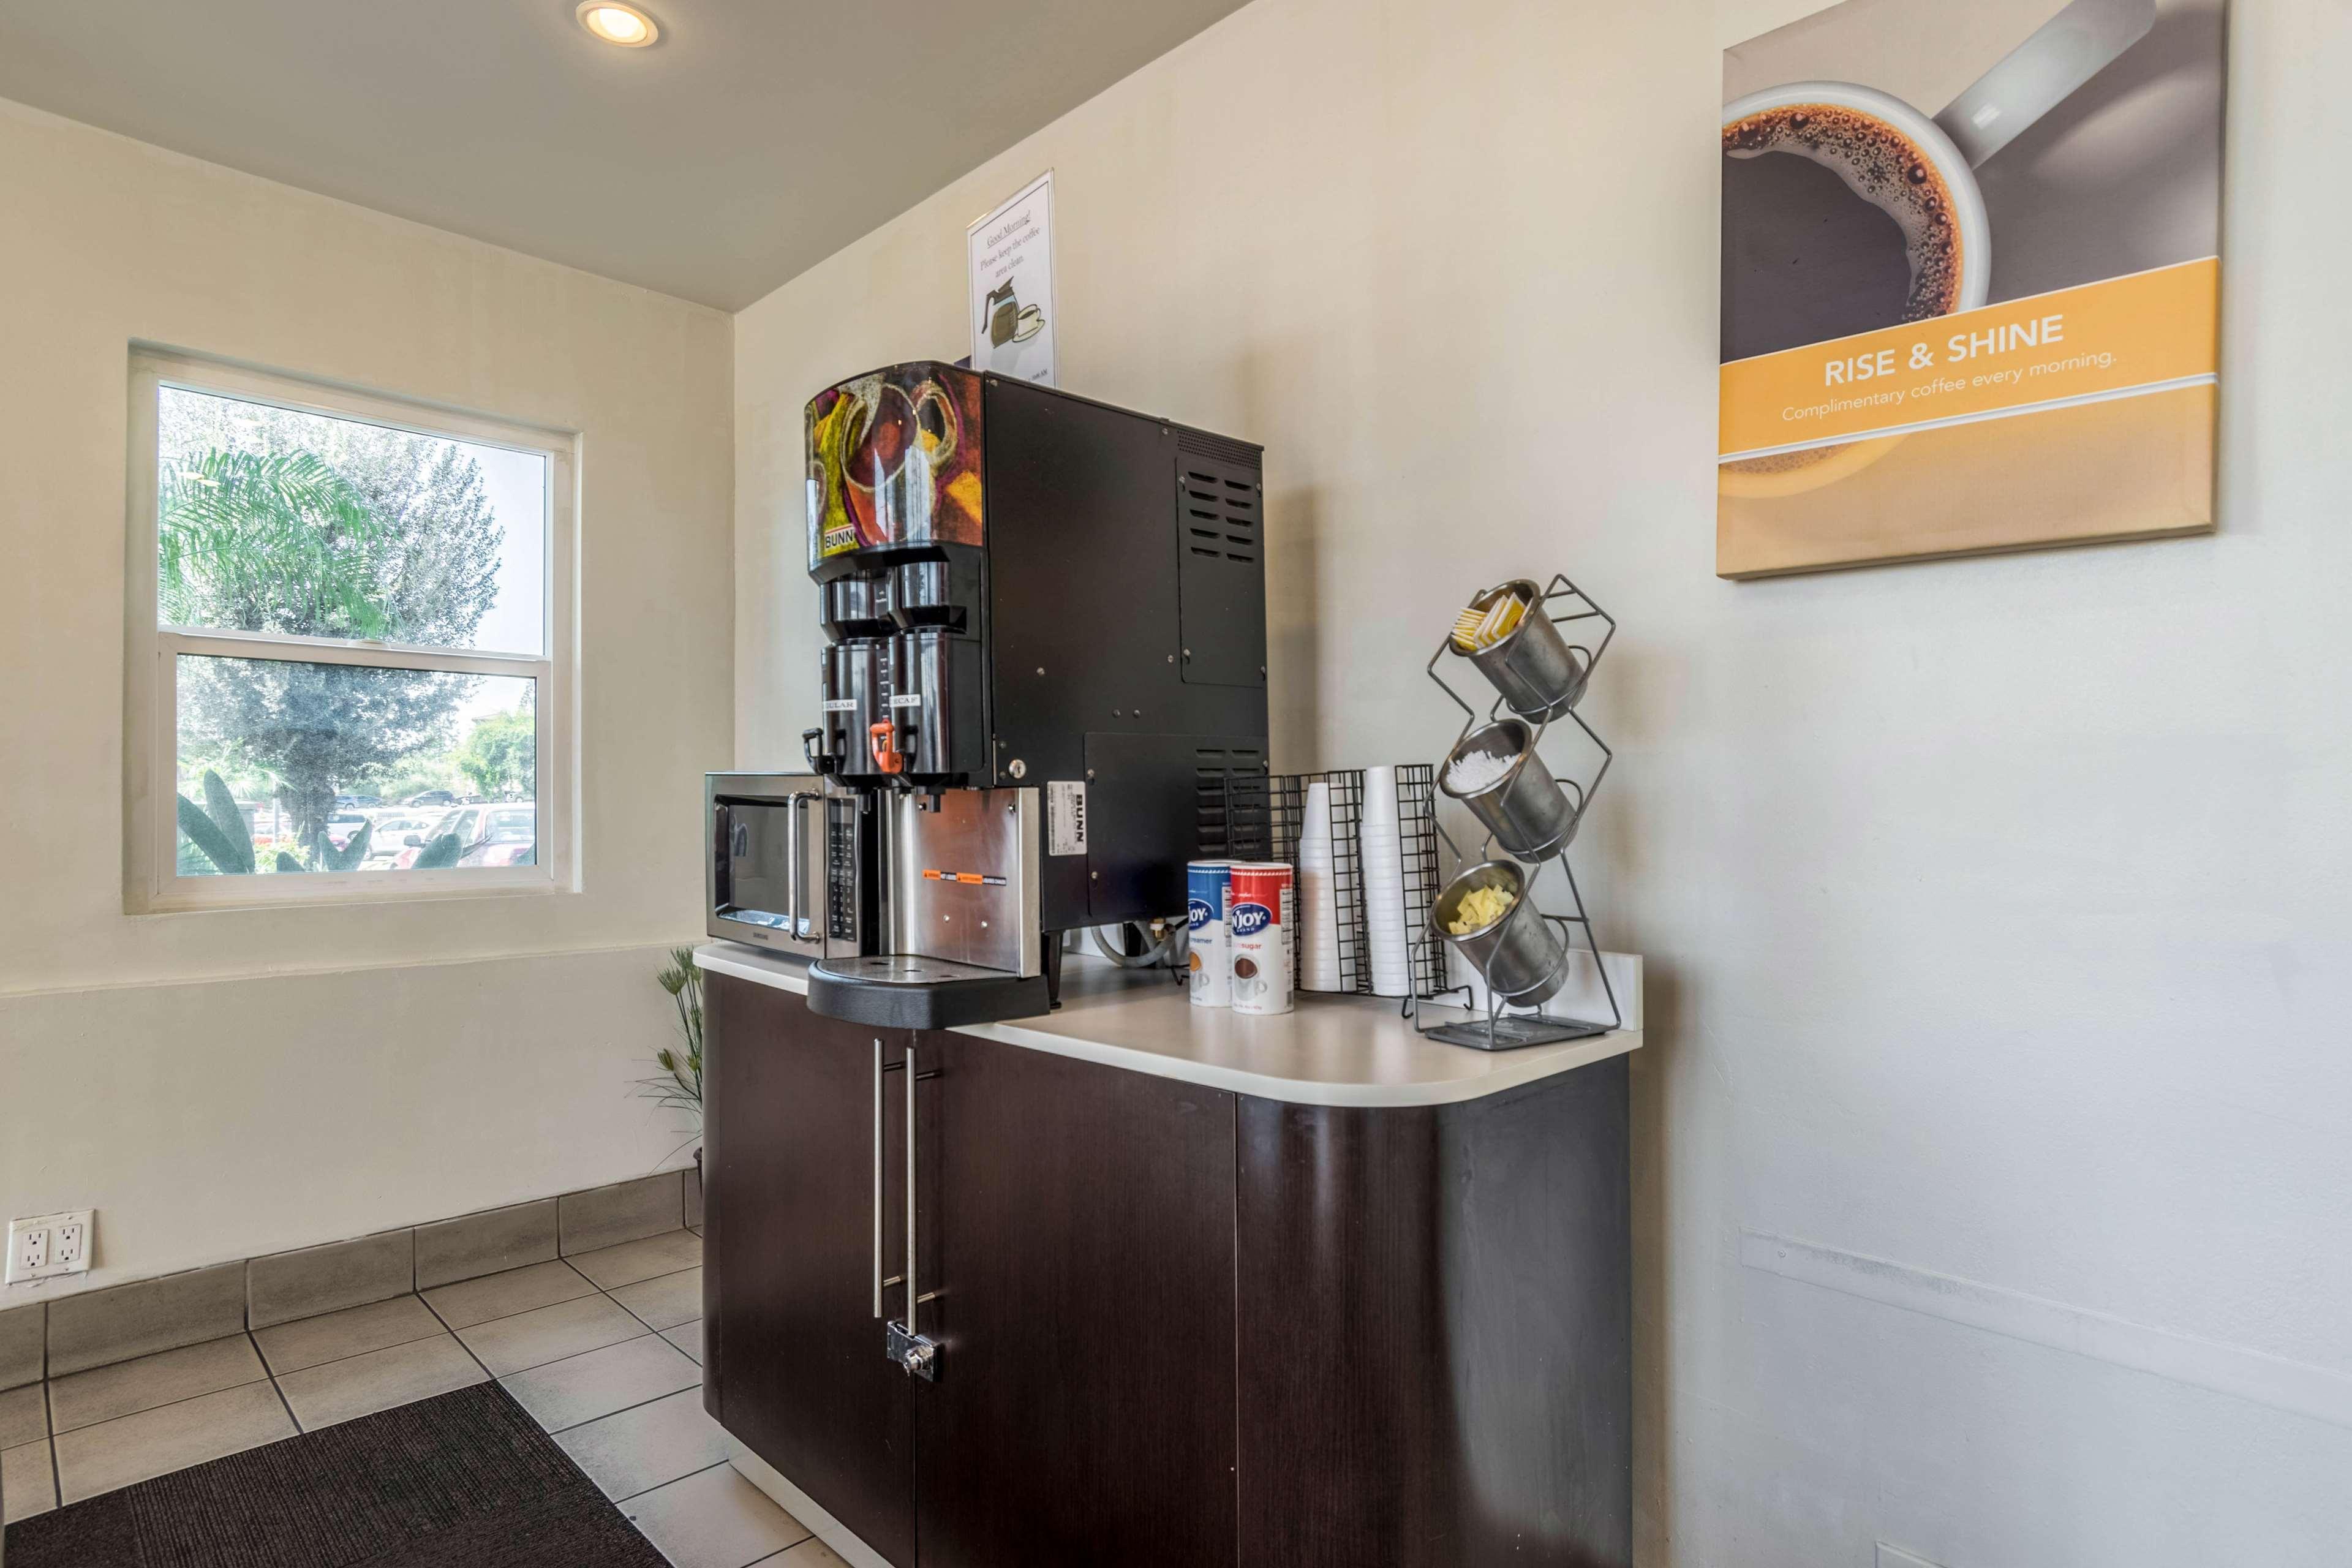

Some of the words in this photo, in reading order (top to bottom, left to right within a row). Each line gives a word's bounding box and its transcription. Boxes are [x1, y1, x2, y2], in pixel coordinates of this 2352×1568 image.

[980, 255, 998, 271] Please
[998, 246, 1012, 259] keep
[1012, 239, 1022, 250] the
[1022, 227, 1040, 243] coffee
[987, 227, 1003, 246] Good
[995, 266, 1008, 278] area
[1825, 349, 1896, 386] RISE
[1908, 342, 1934, 369] &
[1947, 314, 2064, 363] SHINE
[1782, 390, 1905, 421] Complimentary
[1910, 377, 1966, 398] coffee
[1972, 368, 2023, 385] every
[2029, 352, 2117, 377] morning.
[825, 529, 854, 549] BUNN
